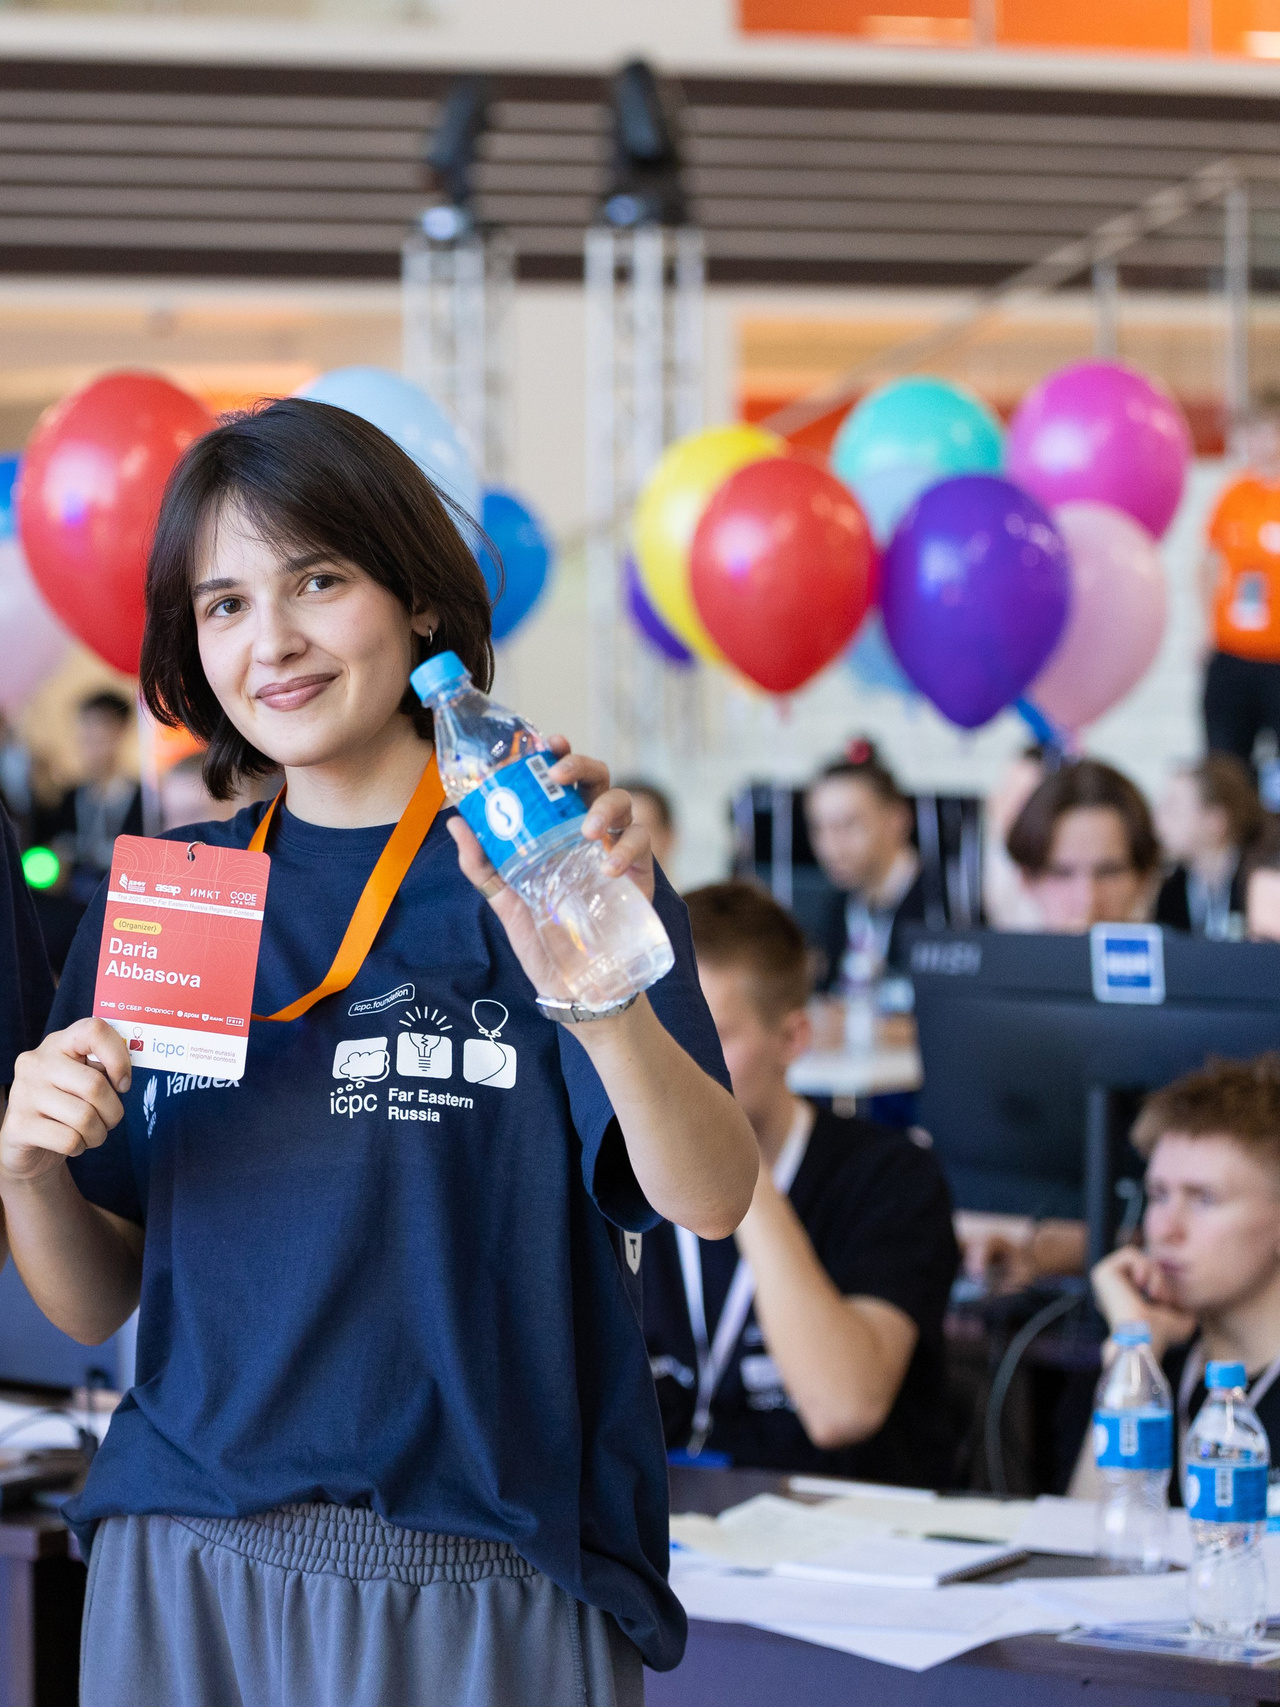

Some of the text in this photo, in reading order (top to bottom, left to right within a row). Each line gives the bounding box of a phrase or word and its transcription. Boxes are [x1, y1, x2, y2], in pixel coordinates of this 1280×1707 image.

[155, 883, 181, 896] asap
[190, 888, 220, 900] ИМКТ
[230, 891, 257, 902] CODE
[142, 897, 157, 905] ICPC
[168, 900, 189, 908] Eastern
[190, 903, 208, 911] Russia
[209, 906, 233, 914] Regional
[234, 909, 255, 917] Contest
[118, 920, 157, 932] {Organizer}
[109, 937, 158, 959] Daria
[105, 960, 201, 988] Abbasova
[354, 988, 408, 1012] icpc.foundation
[152, 1038, 185, 1057] icpc
[190, 1046, 235, 1057] northern eurasia
[190, 1052, 236, 1064] regional contests
[330, 1091, 378, 1118] icpc
[388, 1088, 474, 1109] Far Eastern
[388, 1106, 440, 1122] Russia
